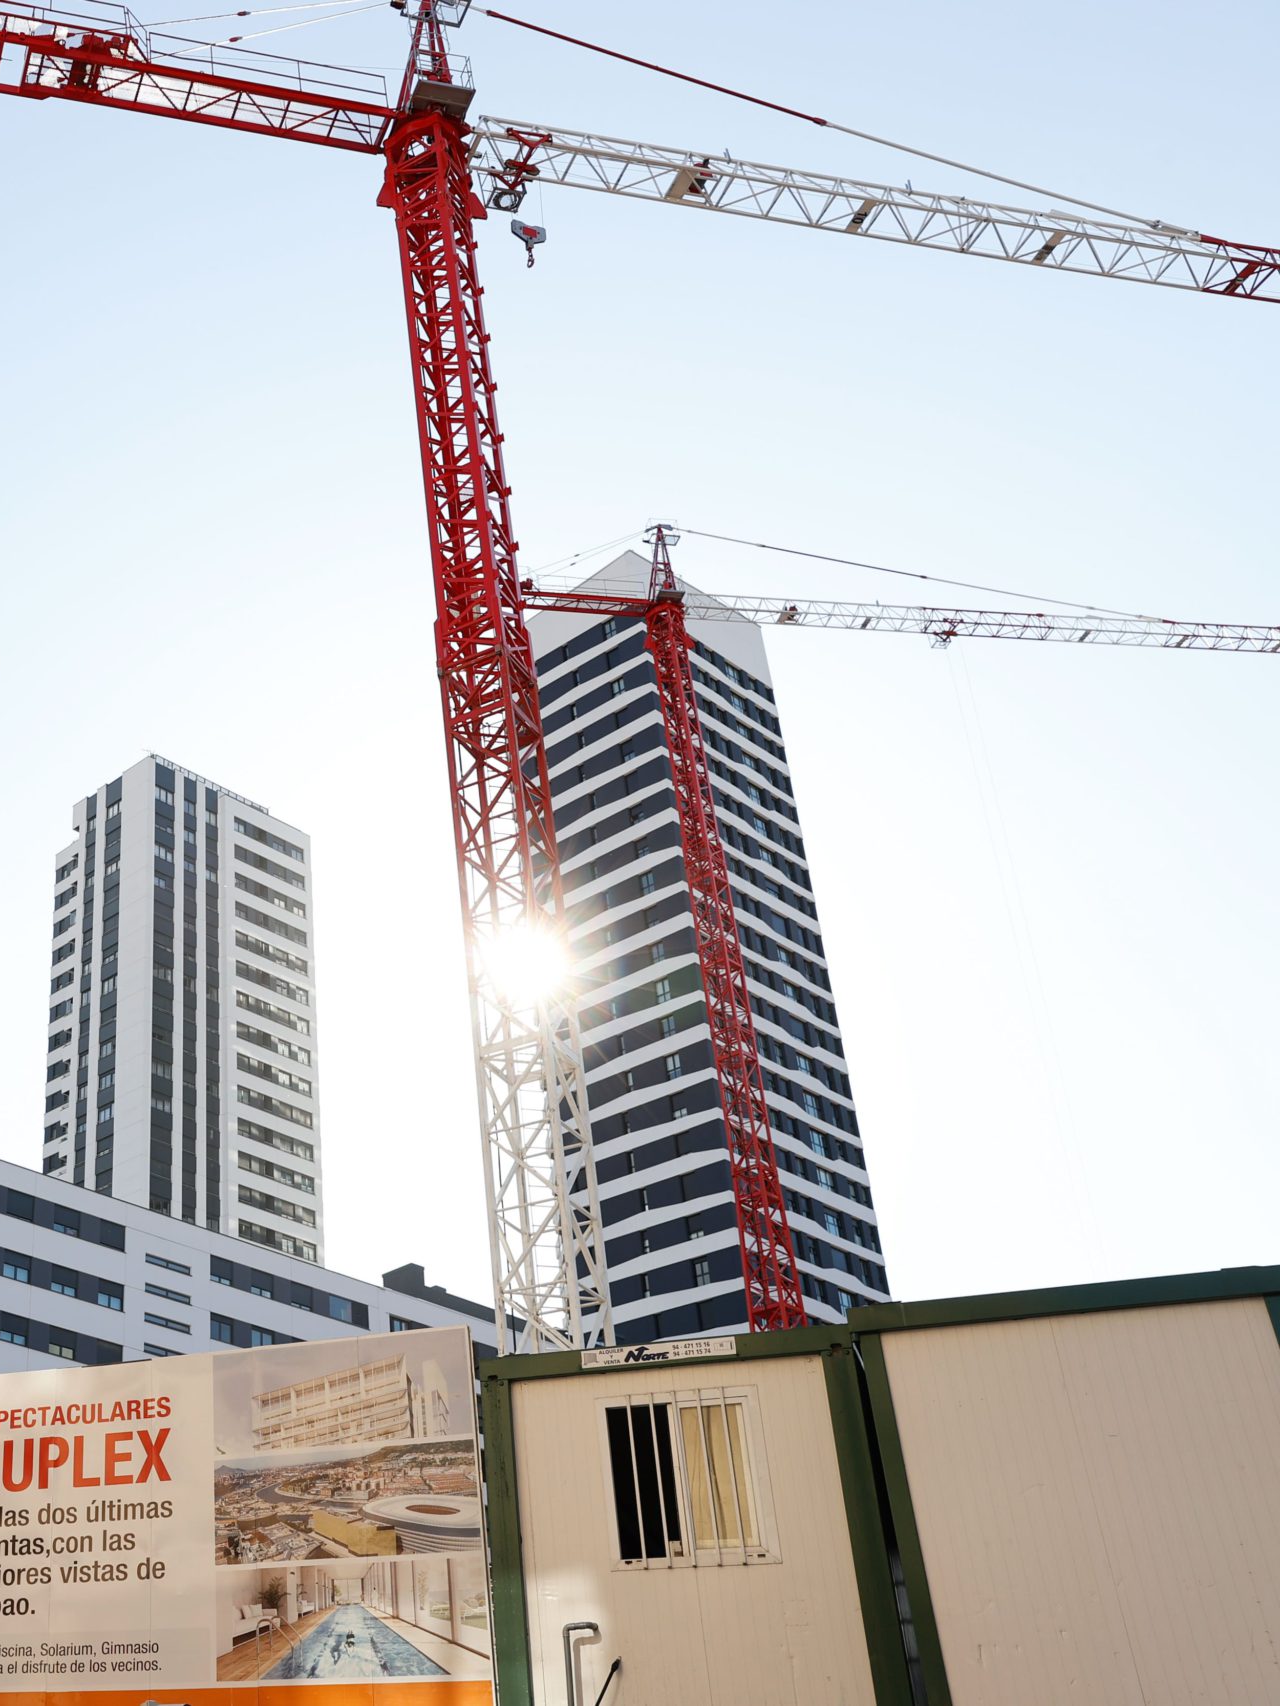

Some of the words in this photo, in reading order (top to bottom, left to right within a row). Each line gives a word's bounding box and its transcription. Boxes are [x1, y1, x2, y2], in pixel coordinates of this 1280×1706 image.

[38, 1503, 77, 1525] dos
[86, 1498, 172, 1522] últimas
[102, 1530, 135, 1551] las
[60, 1559, 128, 1583] vistas
[137, 1557, 165, 1580] de
[40, 1642, 97, 1658] Solarium,
[101, 1641, 159, 1656] Gimnasio
[8, 1661, 18, 1674] el
[21, 1660, 67, 1674] disfrute
[70, 1660, 87, 1673] de
[90, 1659, 106, 1672] los
[111, 1658, 162, 1672] vecinos.
